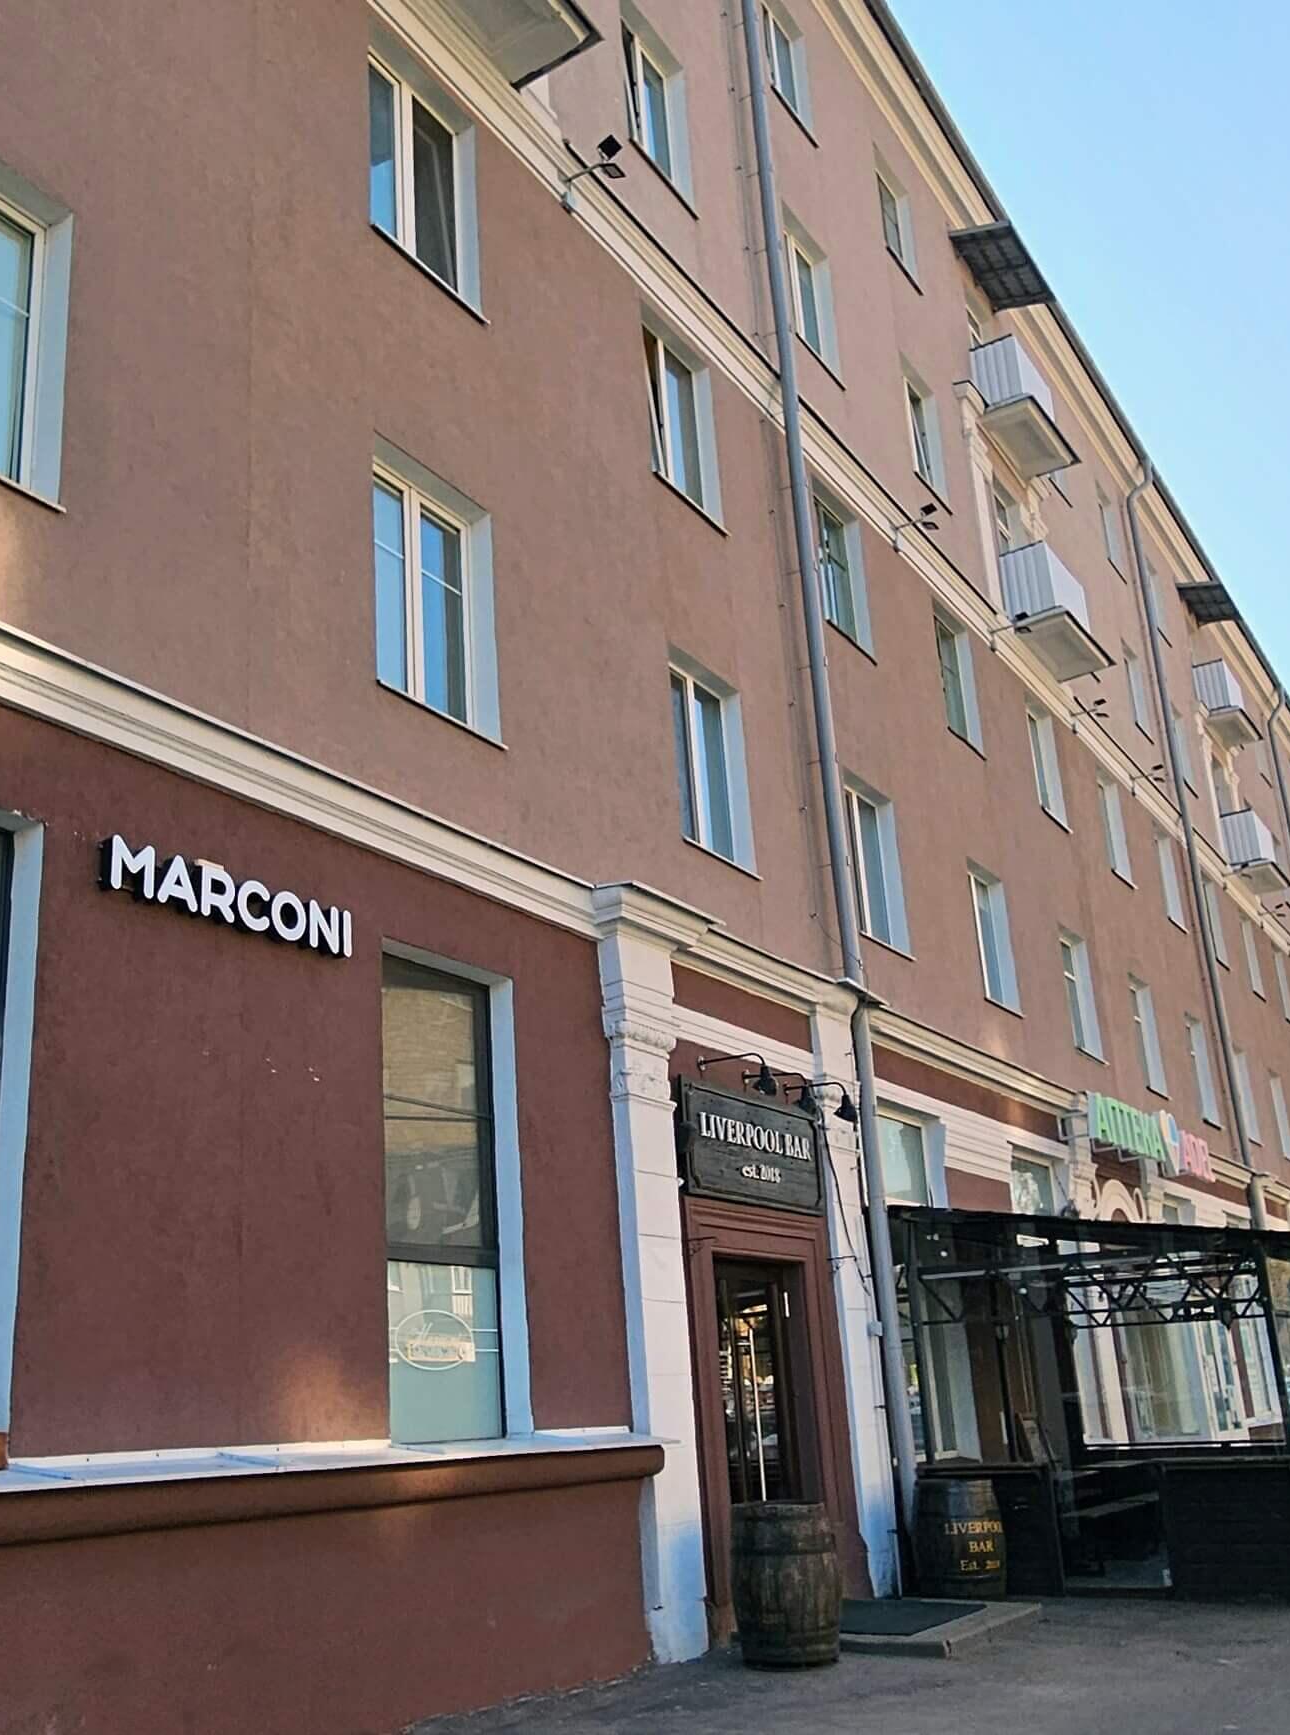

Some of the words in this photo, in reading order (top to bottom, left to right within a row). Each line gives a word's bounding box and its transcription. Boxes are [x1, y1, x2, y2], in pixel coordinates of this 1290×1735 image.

[110, 834, 353, 958] MARCONI
[698, 1111, 784, 1154] LIVERPOOL
[785, 1134, 811, 1161] BAR
[1090, 1092, 1167, 1162] АПТЕКА
[968, 1540, 994, 1553] BAR
